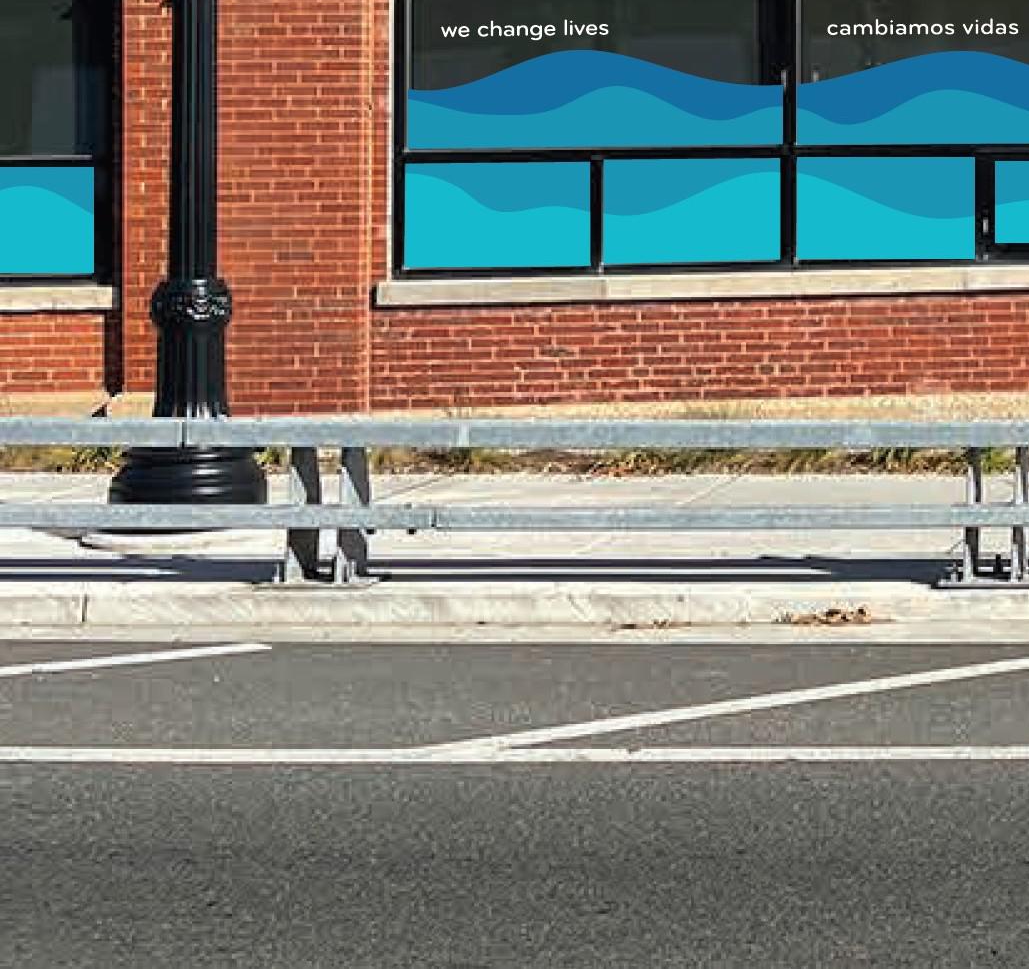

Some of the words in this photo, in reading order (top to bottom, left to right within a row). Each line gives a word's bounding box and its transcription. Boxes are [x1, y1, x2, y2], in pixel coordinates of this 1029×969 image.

[440, 25, 471, 38] we
[477, 20, 557, 41] change
[563, 18, 610, 37] lives
[826, 18, 955, 36] cambiamos
[962, 17, 1020, 36] vidas
